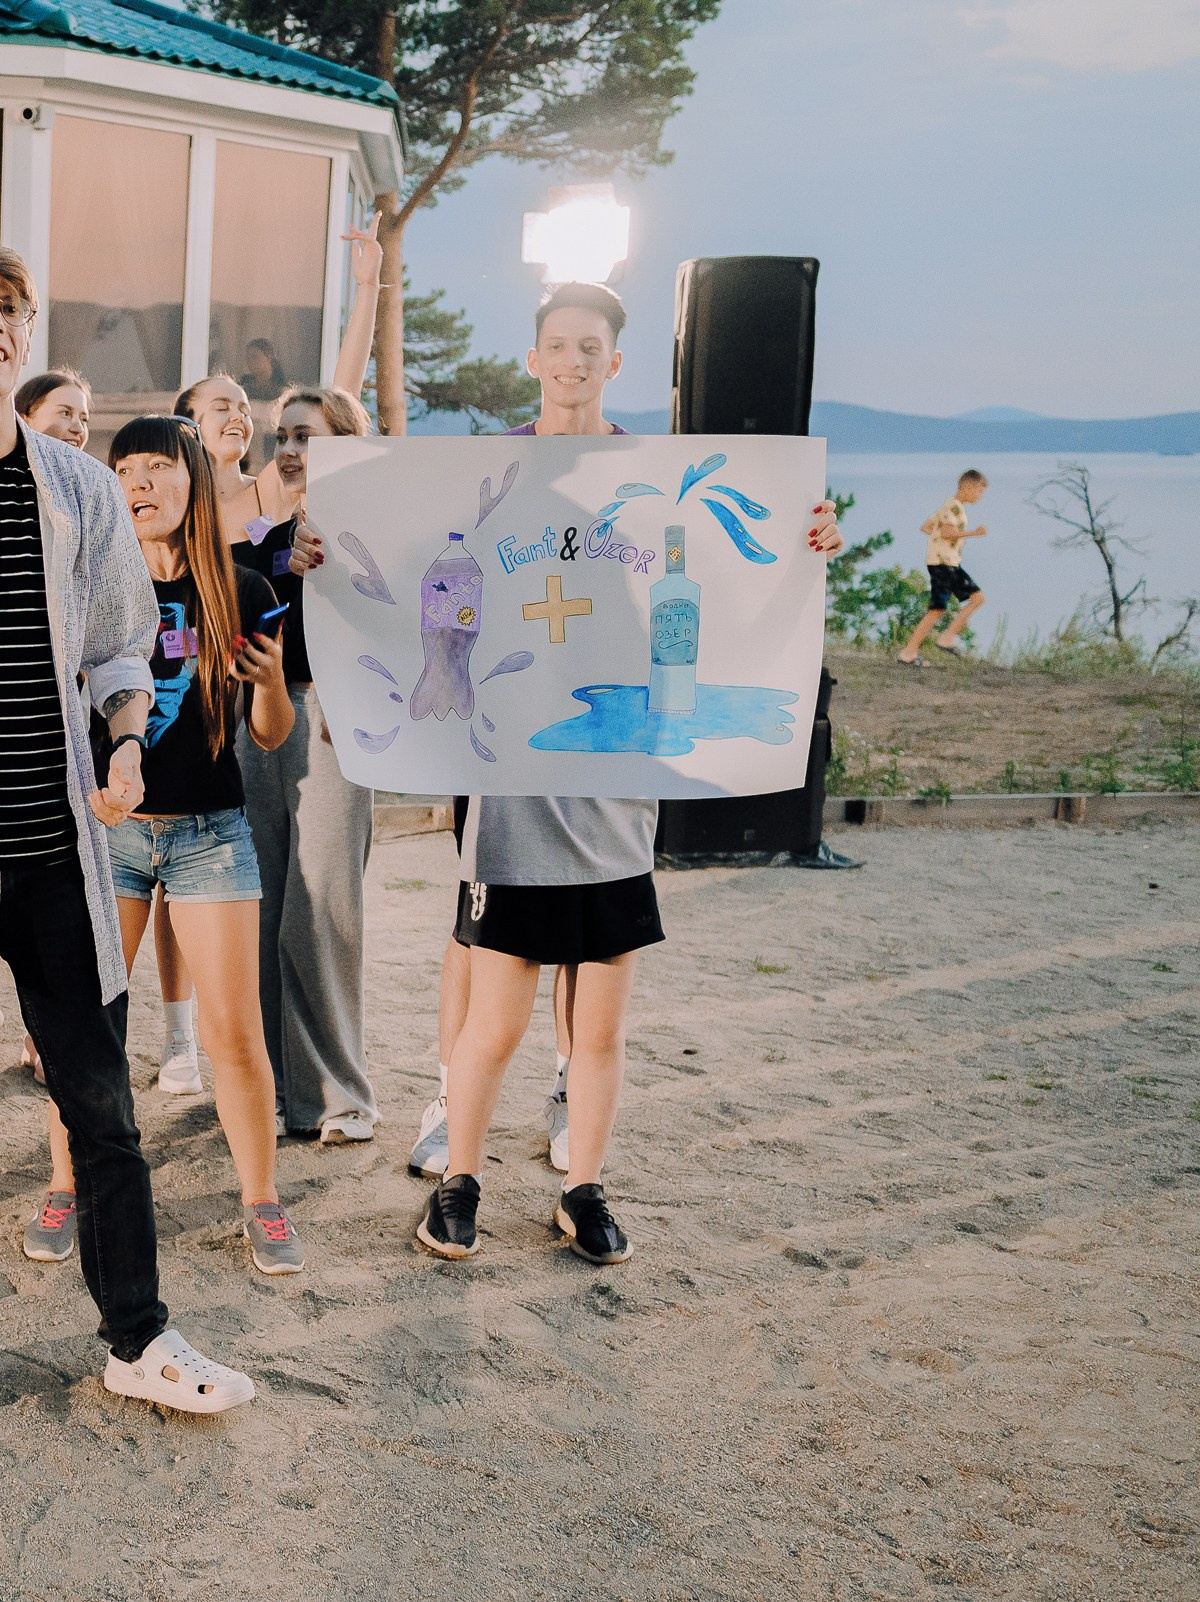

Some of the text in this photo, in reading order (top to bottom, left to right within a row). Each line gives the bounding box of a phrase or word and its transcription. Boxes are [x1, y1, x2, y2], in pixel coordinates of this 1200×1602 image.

[497, 526, 558, 574] Fant
[559, 526, 581, 562] &
[425, 575, 483, 624] Fanta
[655, 613, 693, 624] ПЯТЬ
[655, 629, 691, 640] ОЗЕР
